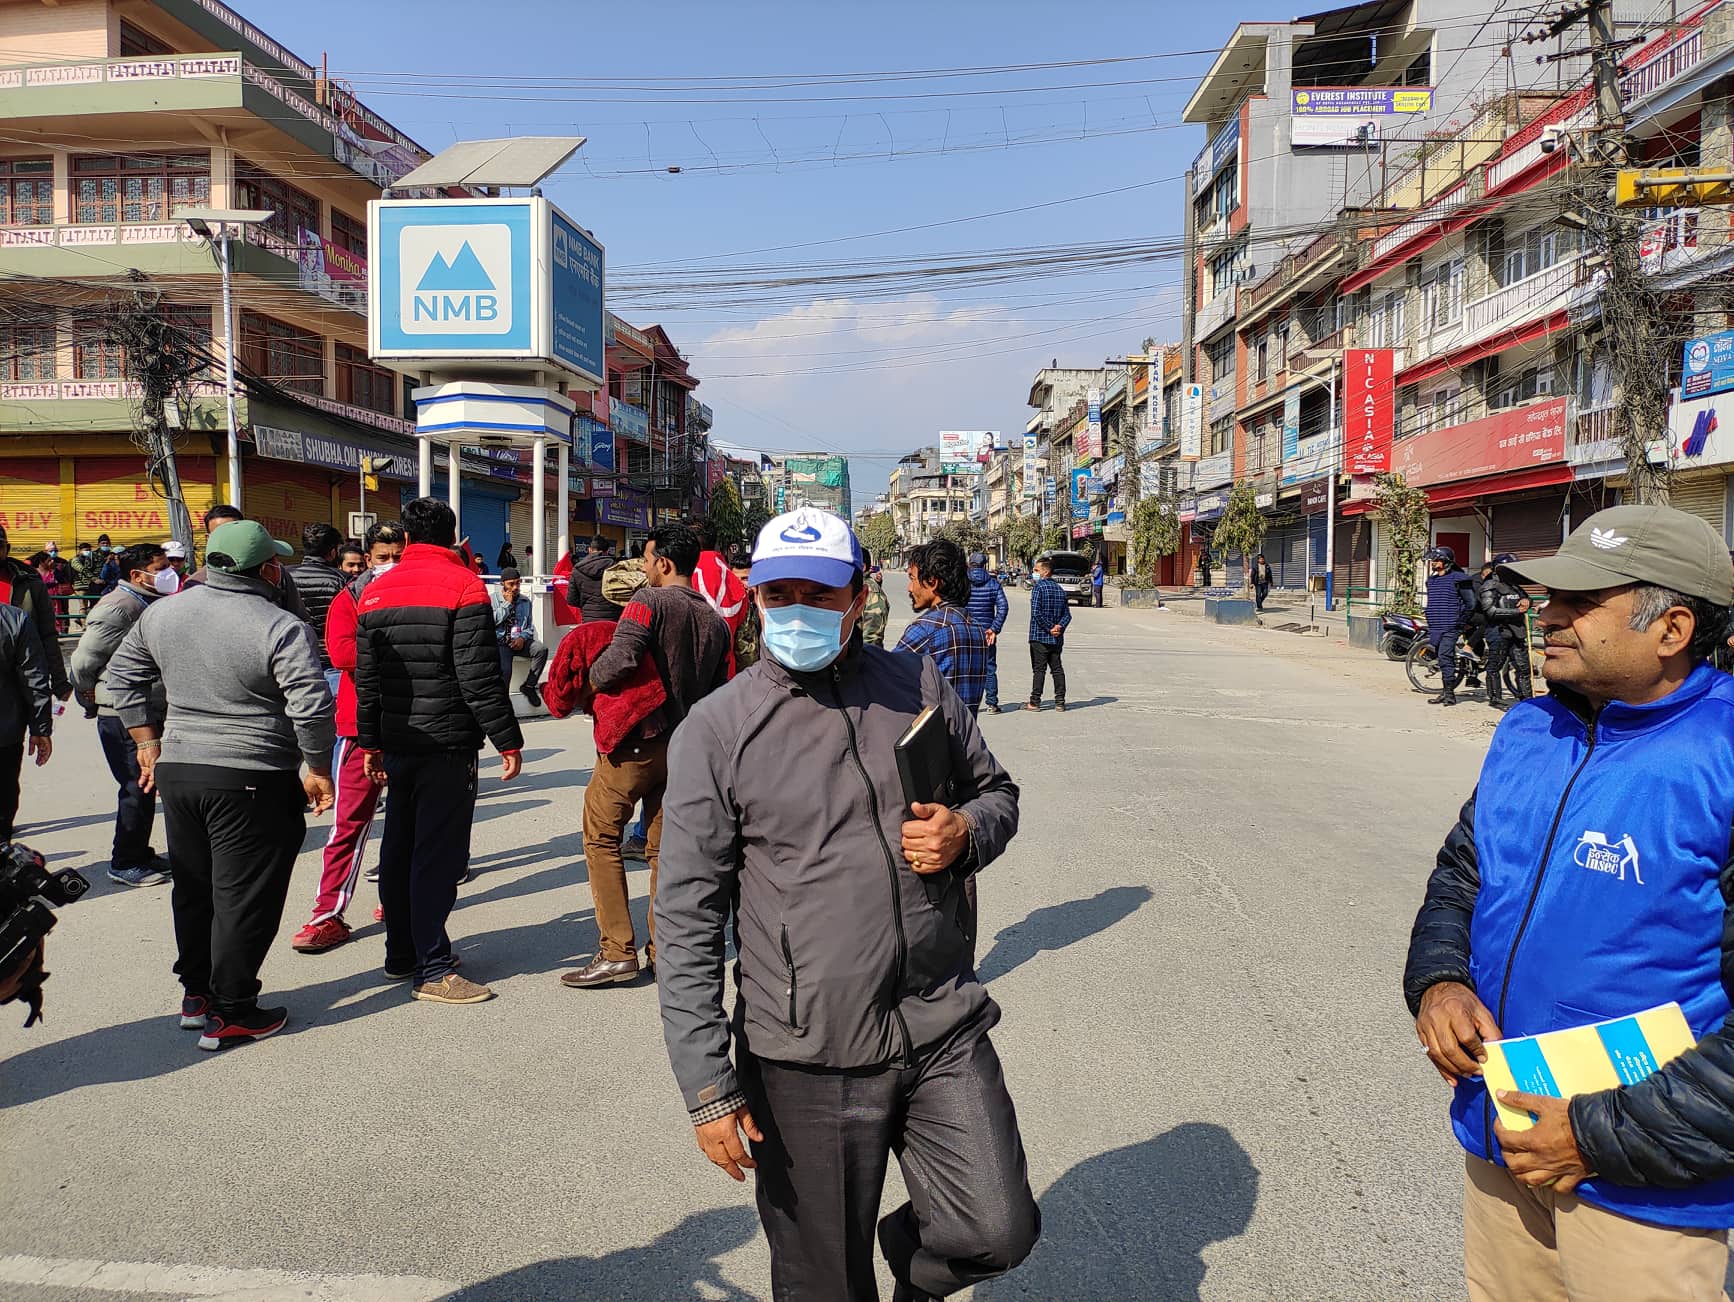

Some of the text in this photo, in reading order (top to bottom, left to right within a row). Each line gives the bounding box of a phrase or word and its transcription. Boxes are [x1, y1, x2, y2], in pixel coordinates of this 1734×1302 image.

[1311, 91, 1345, 101] EVEREST
[1346, 91, 1387, 101] INSTITUTE
[568, 234, 600, 271] NMB BANK
[414, 295, 498, 321] NMB
[306, 438, 343, 464] SHUBHA
[16, 511, 53, 529] PLY
